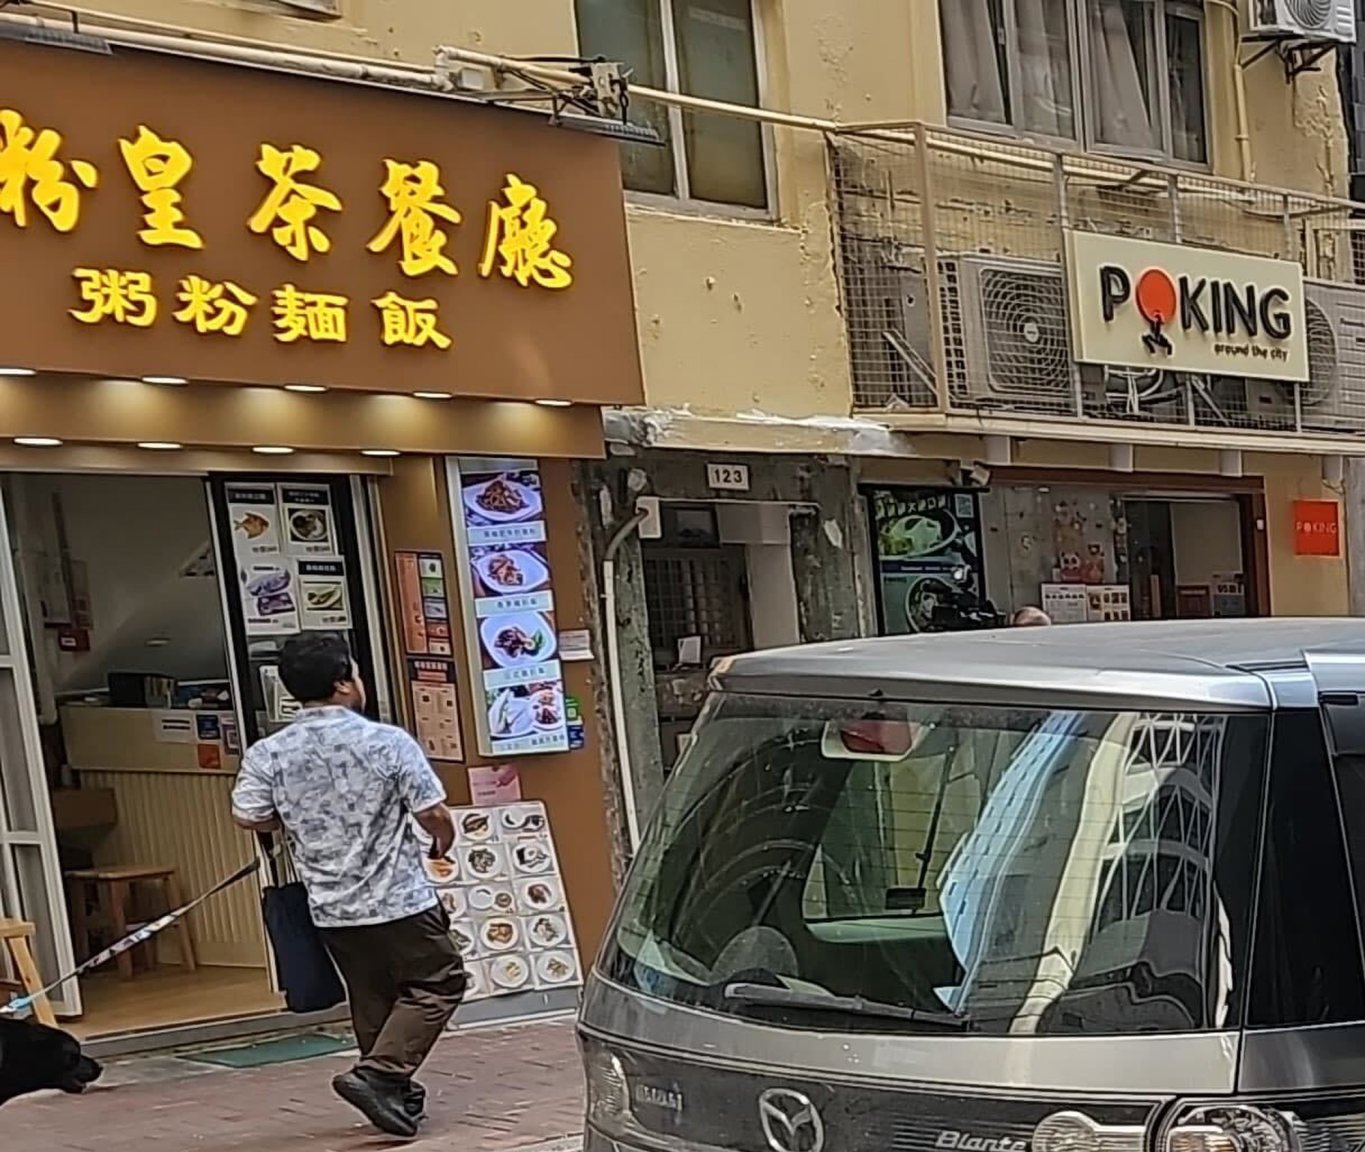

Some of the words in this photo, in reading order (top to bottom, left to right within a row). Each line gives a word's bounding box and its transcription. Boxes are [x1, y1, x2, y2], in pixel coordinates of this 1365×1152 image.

[0, 110, 573, 289] 粉皇茶餐廳
[68, 267, 452, 350] 粥粉麵飯
[1099, 265, 1292, 341] POKING
[1214, 343, 1249, 357] around
[1252, 344, 1268, 358] the
[1271, 347, 1288, 362] city
[714, 469, 743, 483] 123
